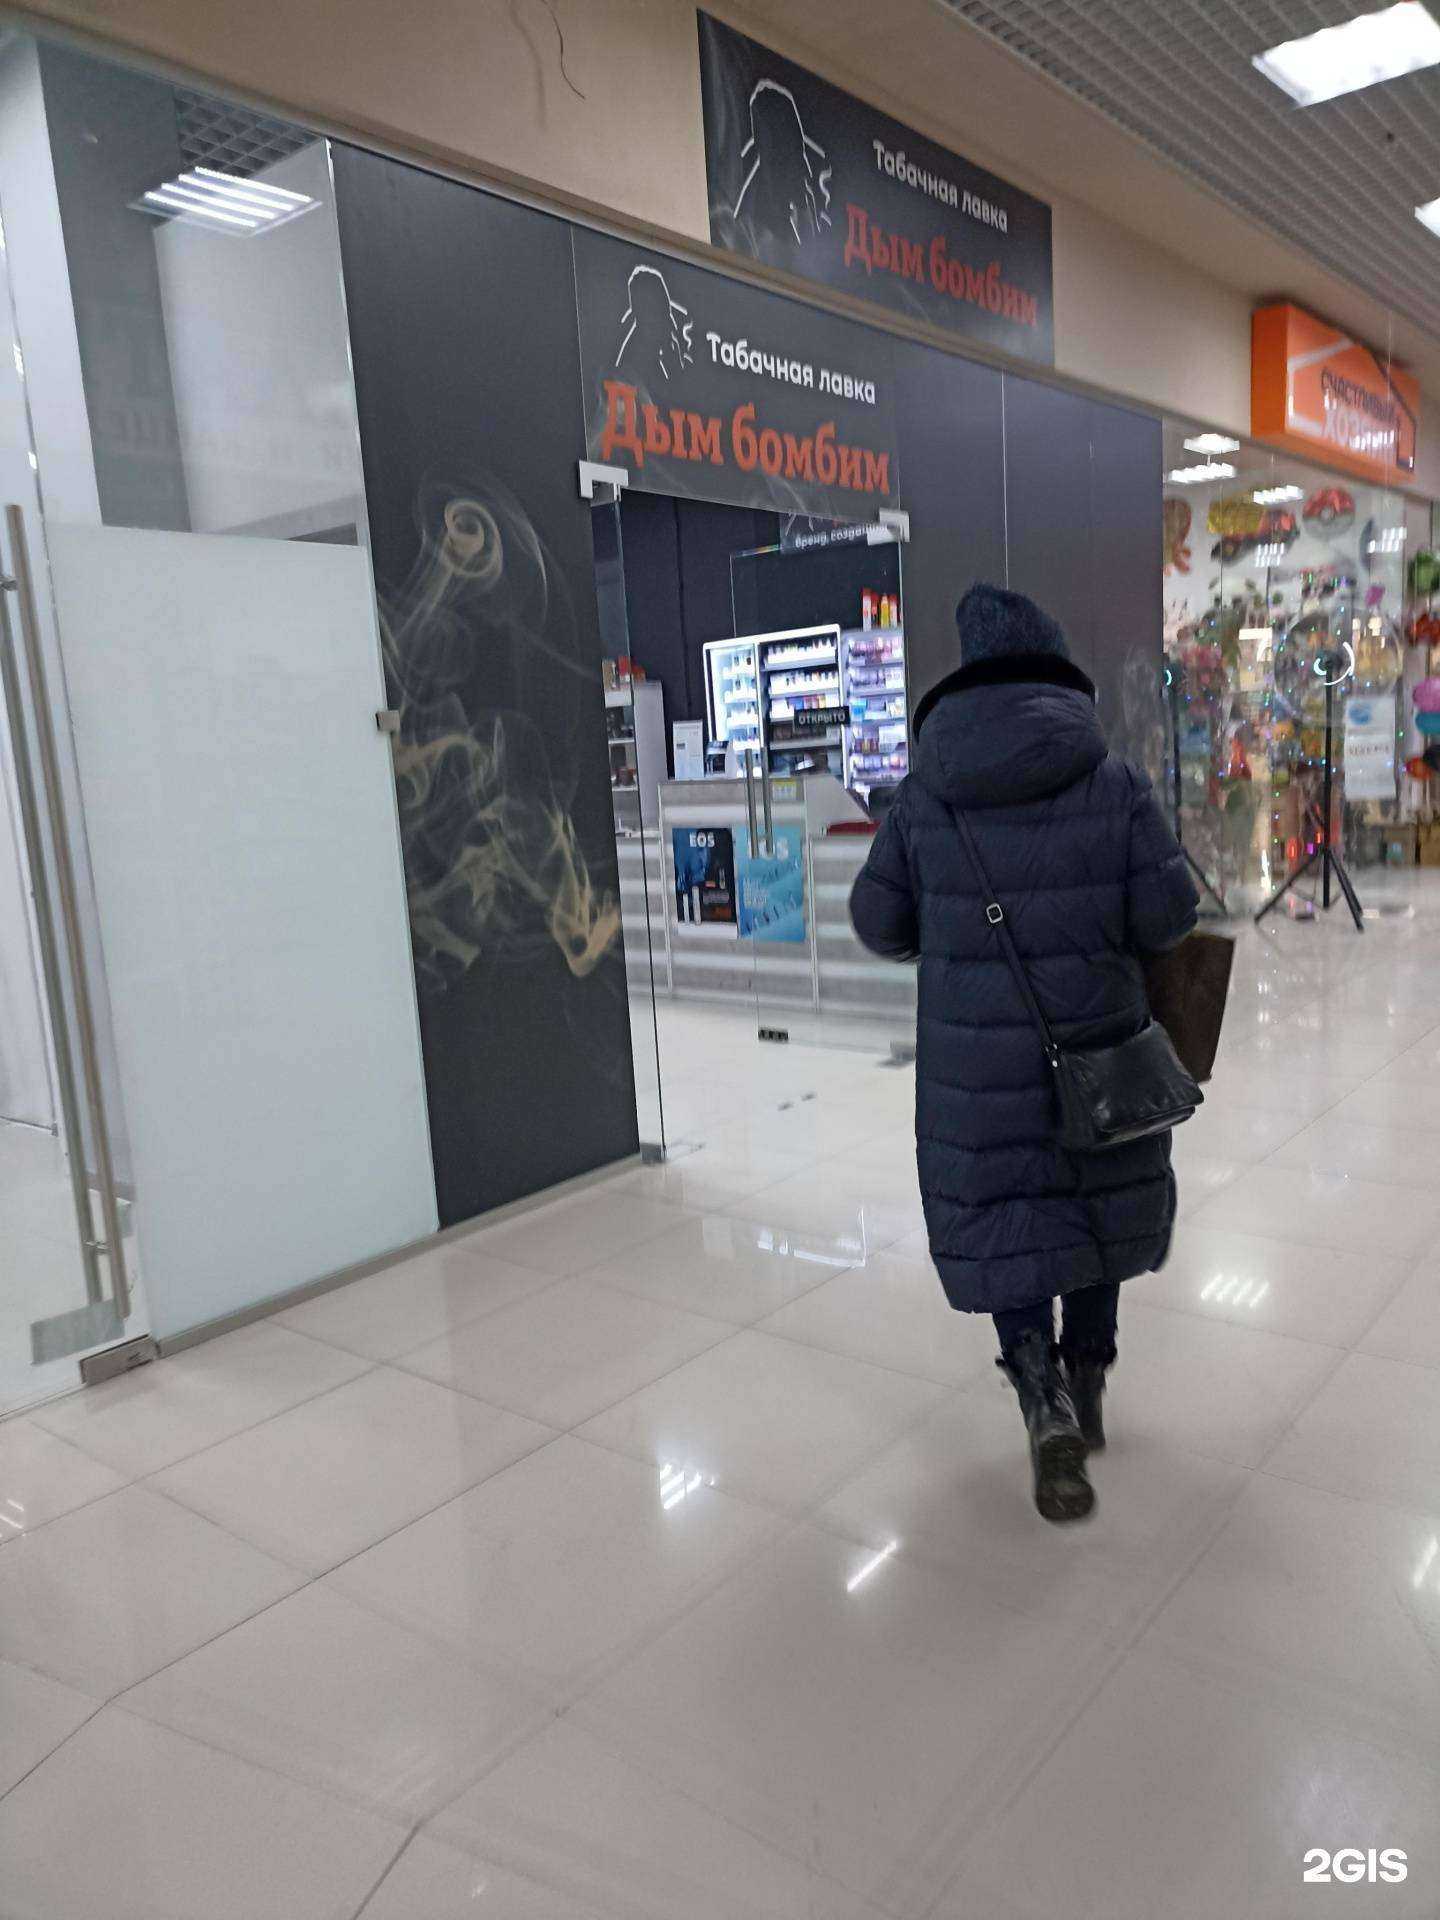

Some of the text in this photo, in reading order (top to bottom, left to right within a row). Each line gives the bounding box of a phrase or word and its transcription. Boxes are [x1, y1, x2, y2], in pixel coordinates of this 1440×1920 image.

[872, 139, 1008, 234] Табачная лавка
[844, 202, 1037, 327] Дым бомбим
[706, 331, 876, 405] Табачная лавка
[602, 379, 890, 495] Дым бомбим
[798, 708, 846, 726] ОТКРЫТО
[689, 832, 715, 848] EOS
